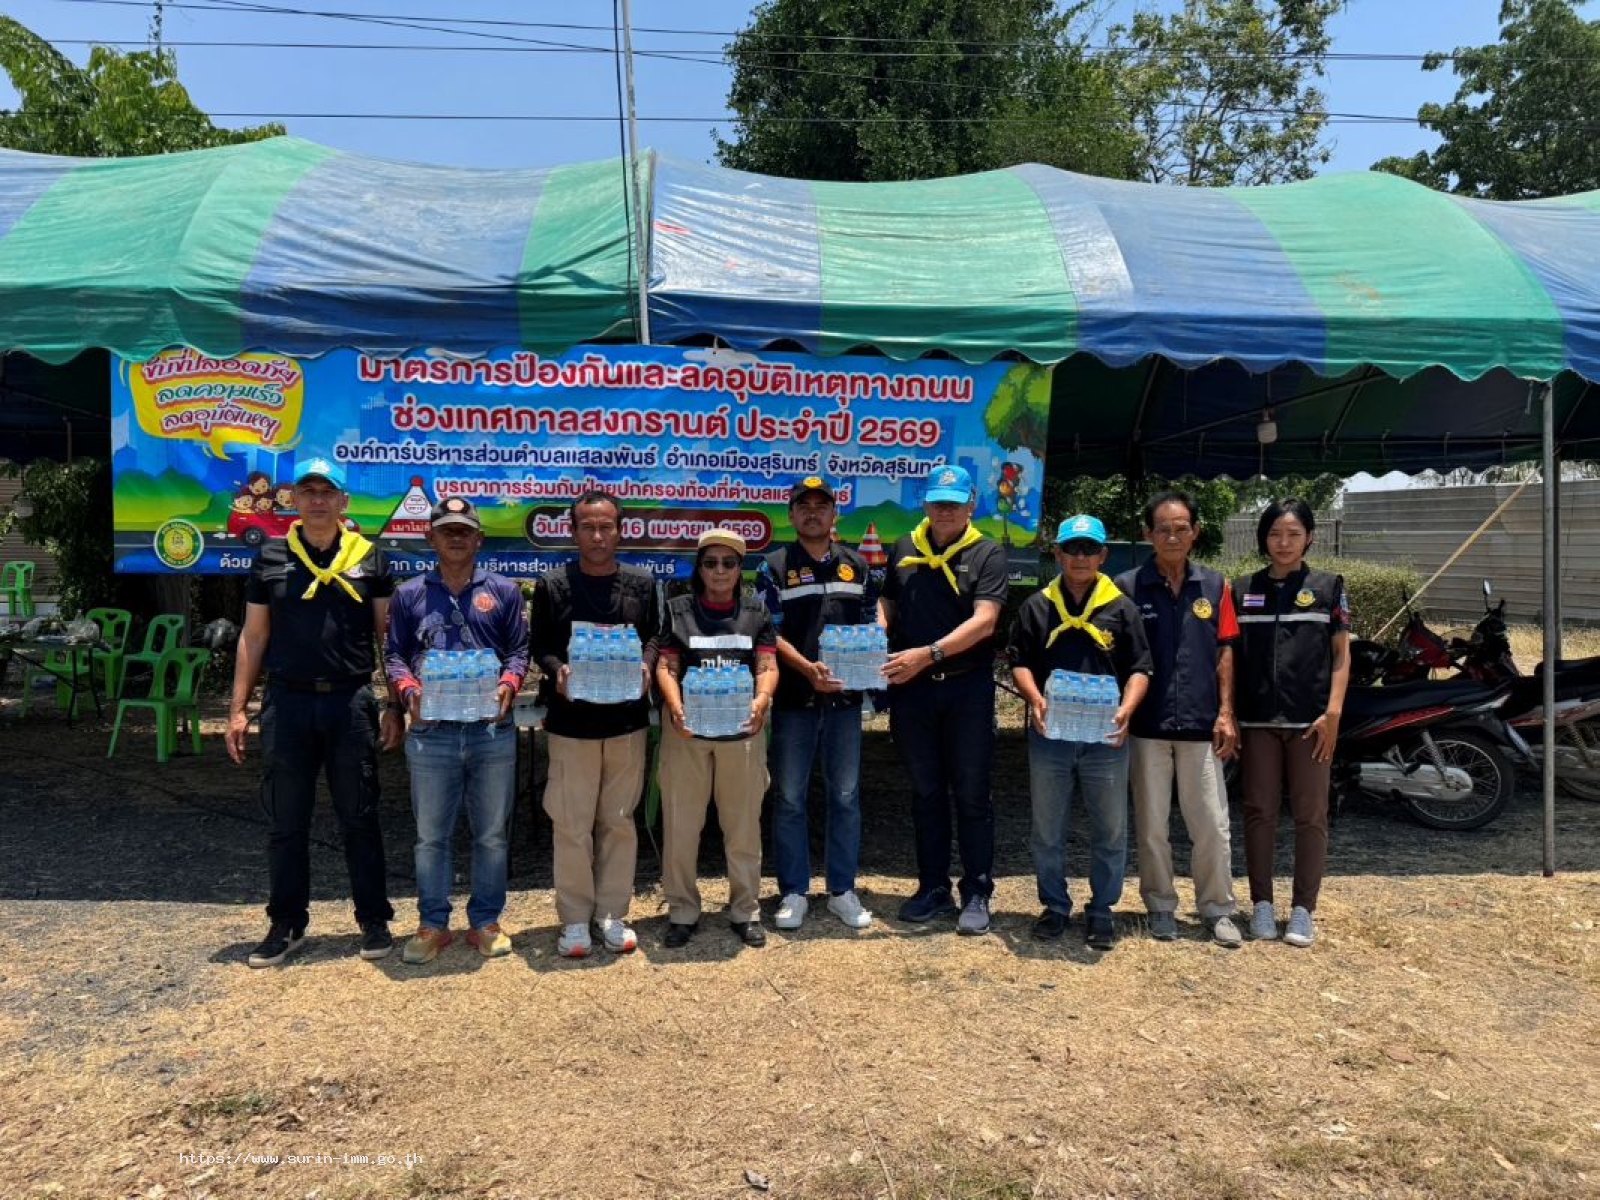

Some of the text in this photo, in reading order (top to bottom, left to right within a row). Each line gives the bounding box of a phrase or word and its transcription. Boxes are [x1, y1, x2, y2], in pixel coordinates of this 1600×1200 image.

[157, 383, 284, 405] ลดความเร็ว
[391, 397, 941, 446] ช่วงเทศกาลสงกรานต์ ประจำปี 2569
[666, 446, 818, 474] อำเภอเมืองสุรินทร์
[827, 453, 946, 479] จังหวัดสุรินท์
